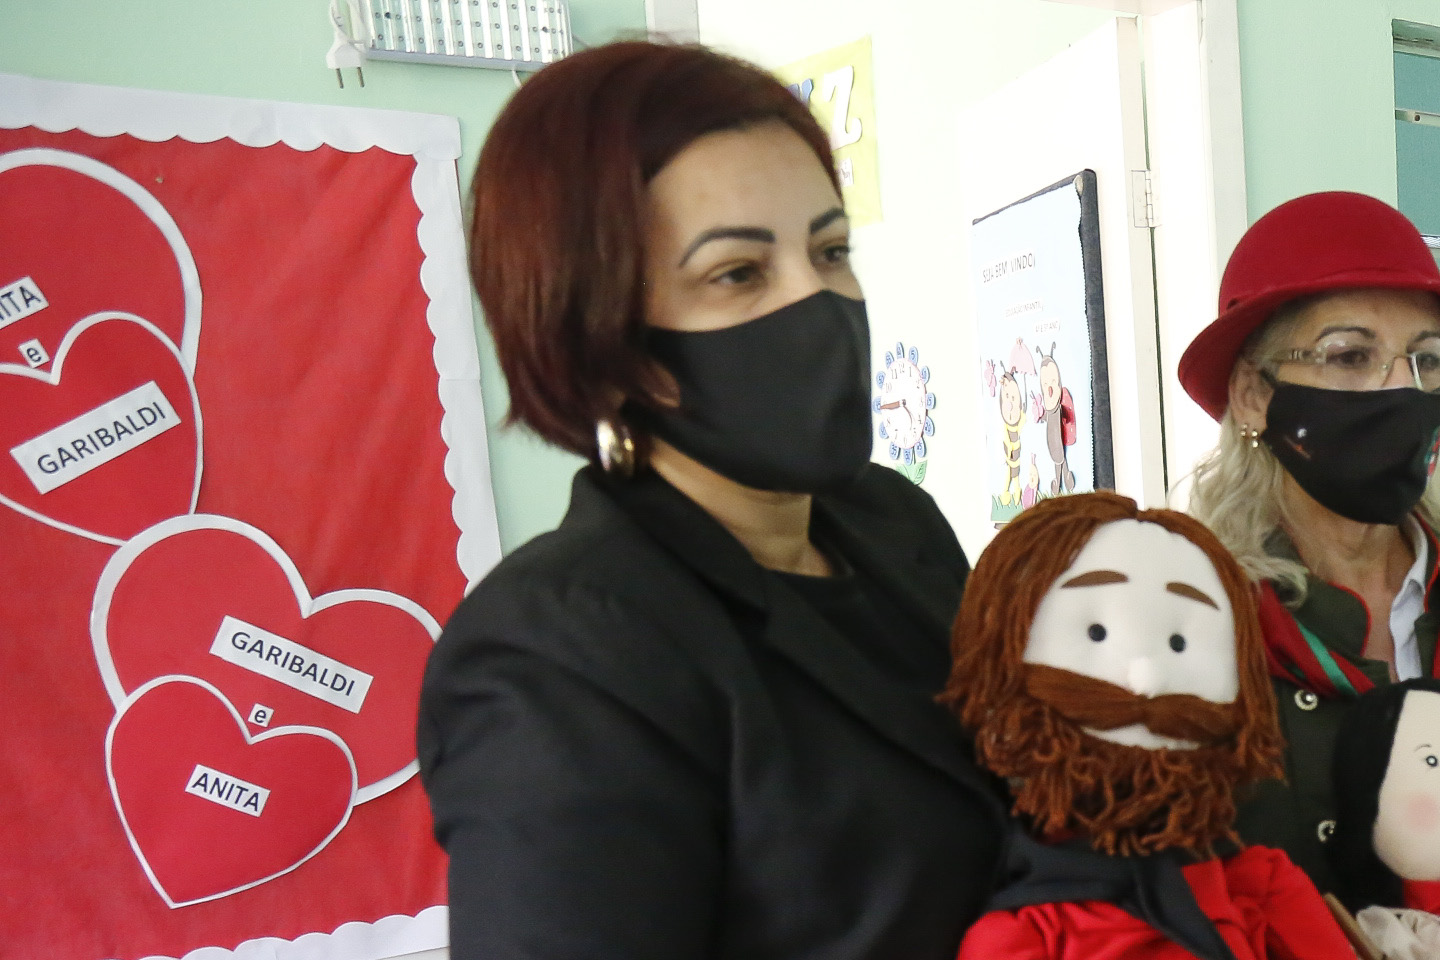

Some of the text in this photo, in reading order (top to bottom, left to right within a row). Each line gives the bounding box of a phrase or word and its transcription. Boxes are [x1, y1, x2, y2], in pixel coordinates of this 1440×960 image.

[0, 286, 42, 320] ITA
[26, 346, 42, 363] e
[37, 401, 167, 476] GARIBALDI
[230, 631, 356, 697] GARIBALDI
[254, 707, 268, 724] e
[191, 772, 260, 812] ANITA
